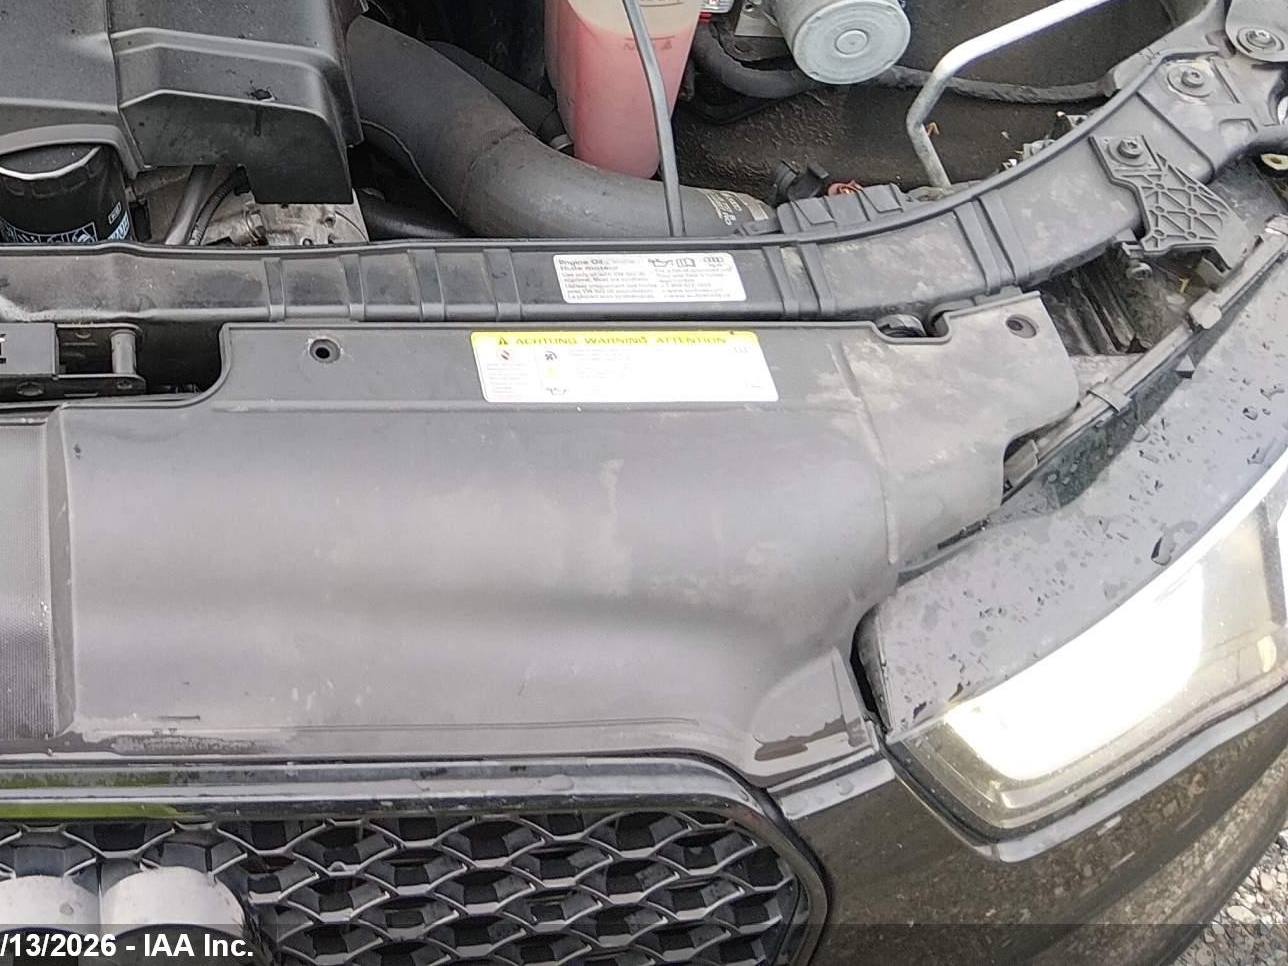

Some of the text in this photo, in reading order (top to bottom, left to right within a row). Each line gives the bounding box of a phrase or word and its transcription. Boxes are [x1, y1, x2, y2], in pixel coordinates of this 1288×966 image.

[558, 258, 589, 267] Engine
[516, 335, 727, 346] ACHTUNG WARNING ATTENTION
